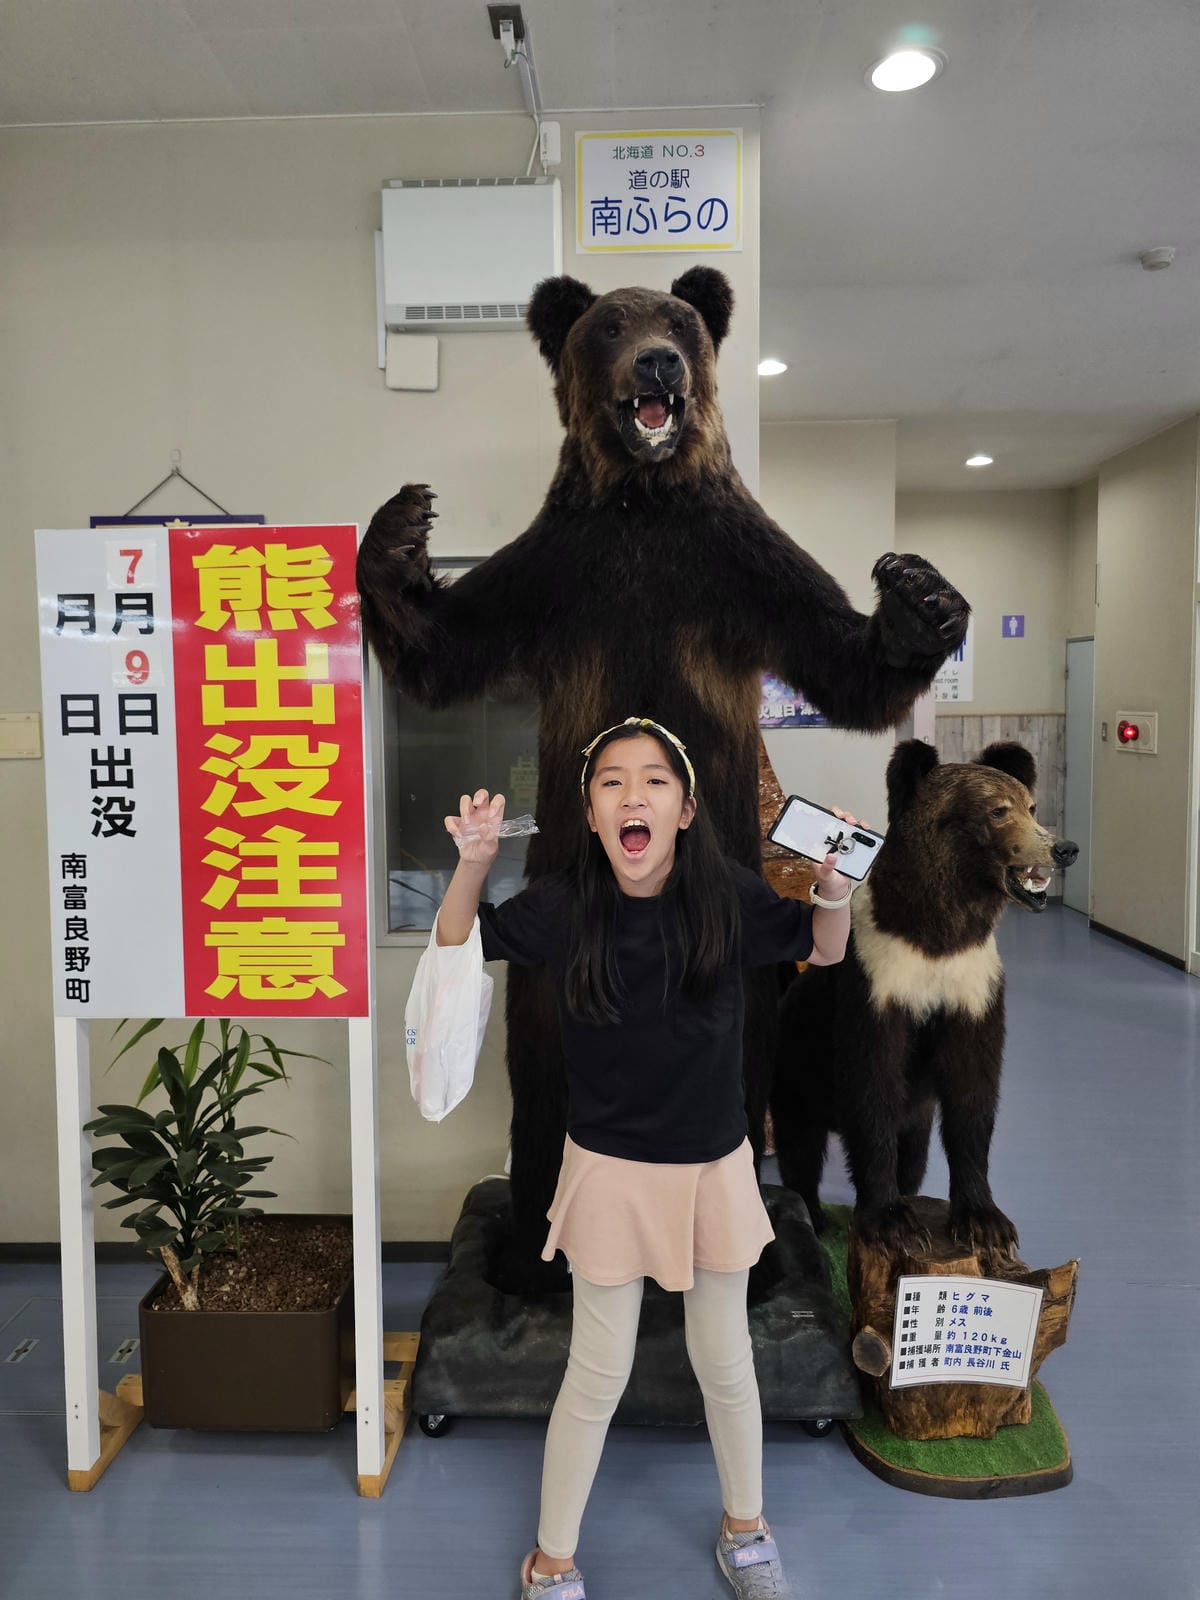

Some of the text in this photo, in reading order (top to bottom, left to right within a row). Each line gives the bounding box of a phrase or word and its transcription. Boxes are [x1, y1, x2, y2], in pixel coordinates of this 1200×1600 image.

[612, 144, 705, 160] 北海道 NO.3
[628, 168, 690, 190] 道の駅
[590, 196, 729, 236] 南ふらの
[192, 543, 348, 1000] 熊出没注意
[90, 745, 137, 838] 出没
[61, 853, 91, 1003] 南富良野町
[949, 1318, 967, 1327] メス
[945, 1344, 1022, 1360] 南富良野町下金山
[943, 1357, 962, 1367] 町内
[736, 1550, 760, 1563] FILA
[561, 1585, 584, 1600] FILA
